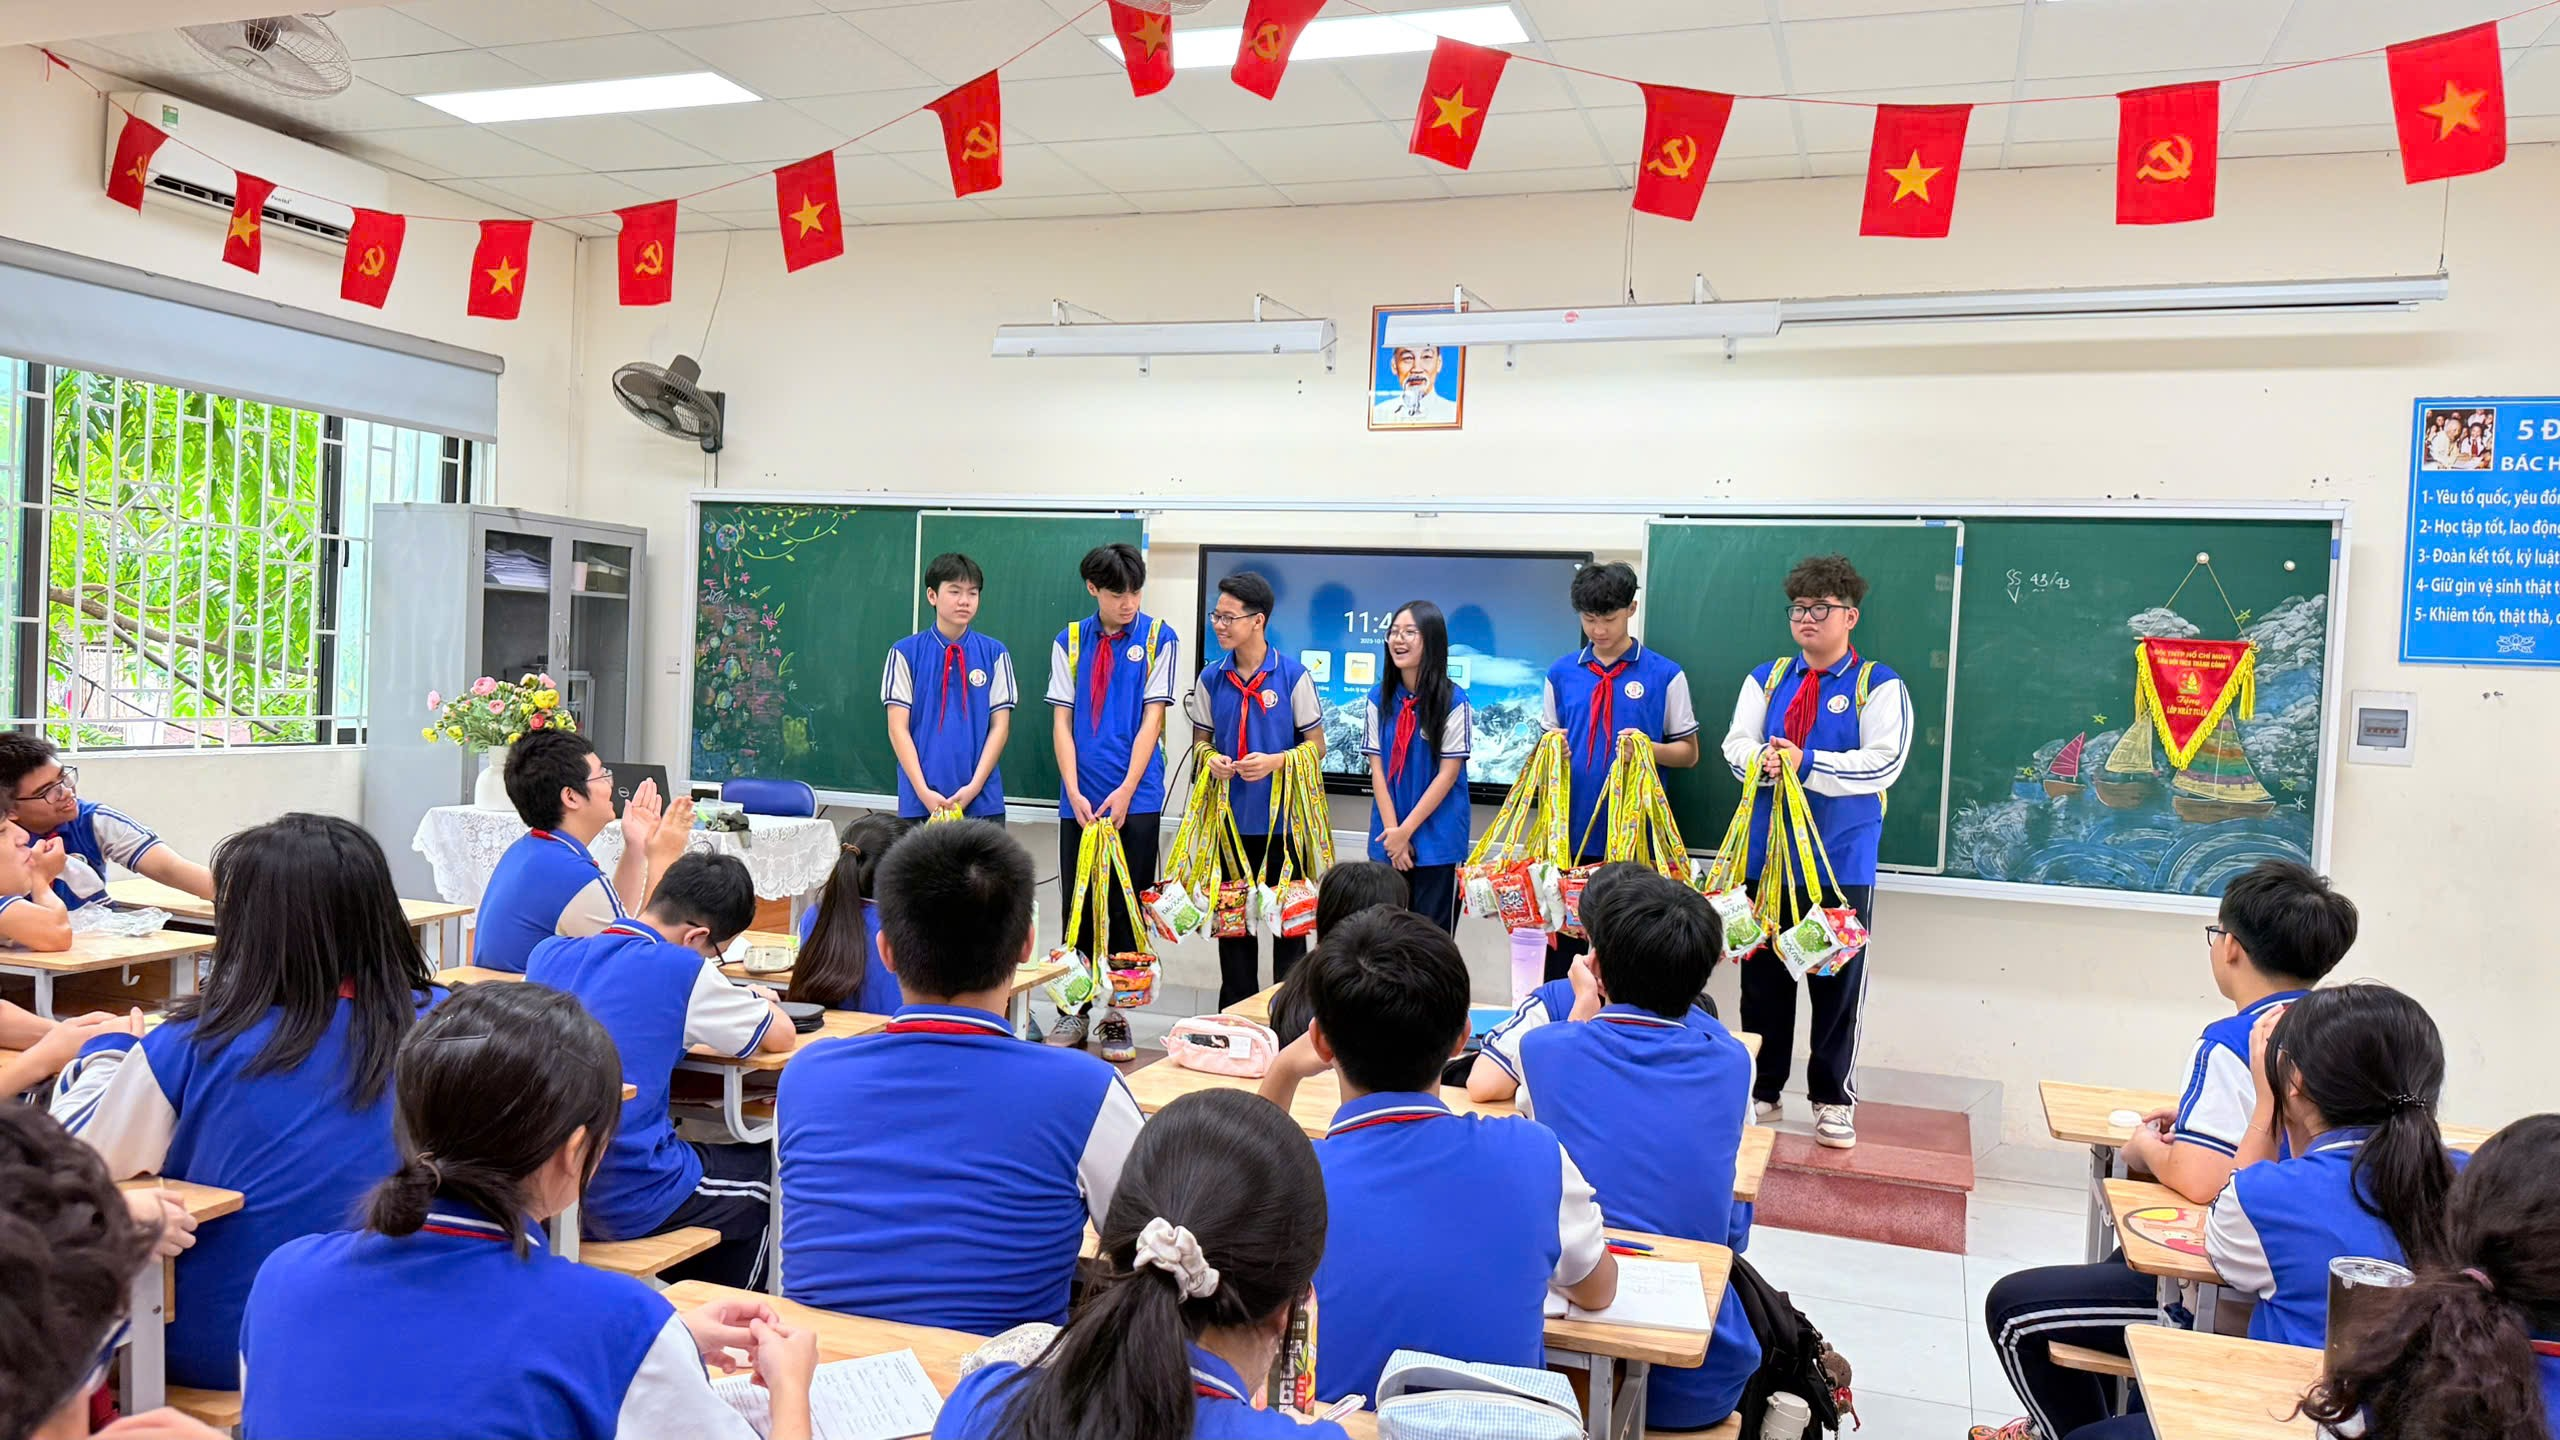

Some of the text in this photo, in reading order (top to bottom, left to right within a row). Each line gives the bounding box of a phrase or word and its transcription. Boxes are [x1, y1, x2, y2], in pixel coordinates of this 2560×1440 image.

[2517, 419, 2534, 441] 5
[2501, 453, 2544, 471] BÁC
[2421, 490, 2434, 504] 1-
[2436, 489, 2458, 504] Yêu
[2461, 487, 2474, 504] tổ
[2476, 487, 2511, 508] quốc,
[2514, 489, 2538, 508] yêu
[2419, 519, 2432, 533] 2-
[2434, 519, 2459, 538] Học
[2461, 518, 2482, 538] tập
[2485, 517, 2506, 536] tốt,
[2510, 519, 2530, 534] lao
[2418, 546, 2560, 568] 3- Đoàn kết tốt, kỷ luật
[2415, 577, 2429, 592] 4-
[2431, 577, 2454, 592] Giữ
[2455, 577, 2475, 597] gìn
[2478, 578, 2493, 597] vệ
[2495, 578, 2522, 594] sinh
[2525, 578, 2552, 599] thật
[2414, 606, 2427, 621] 5-
[2429, 606, 2469, 622] Khiêm
[2472, 605, 2496, 624] tốn,
[2499, 608, 2526, 628] thật
[2528, 608, 2553, 626] thà,
